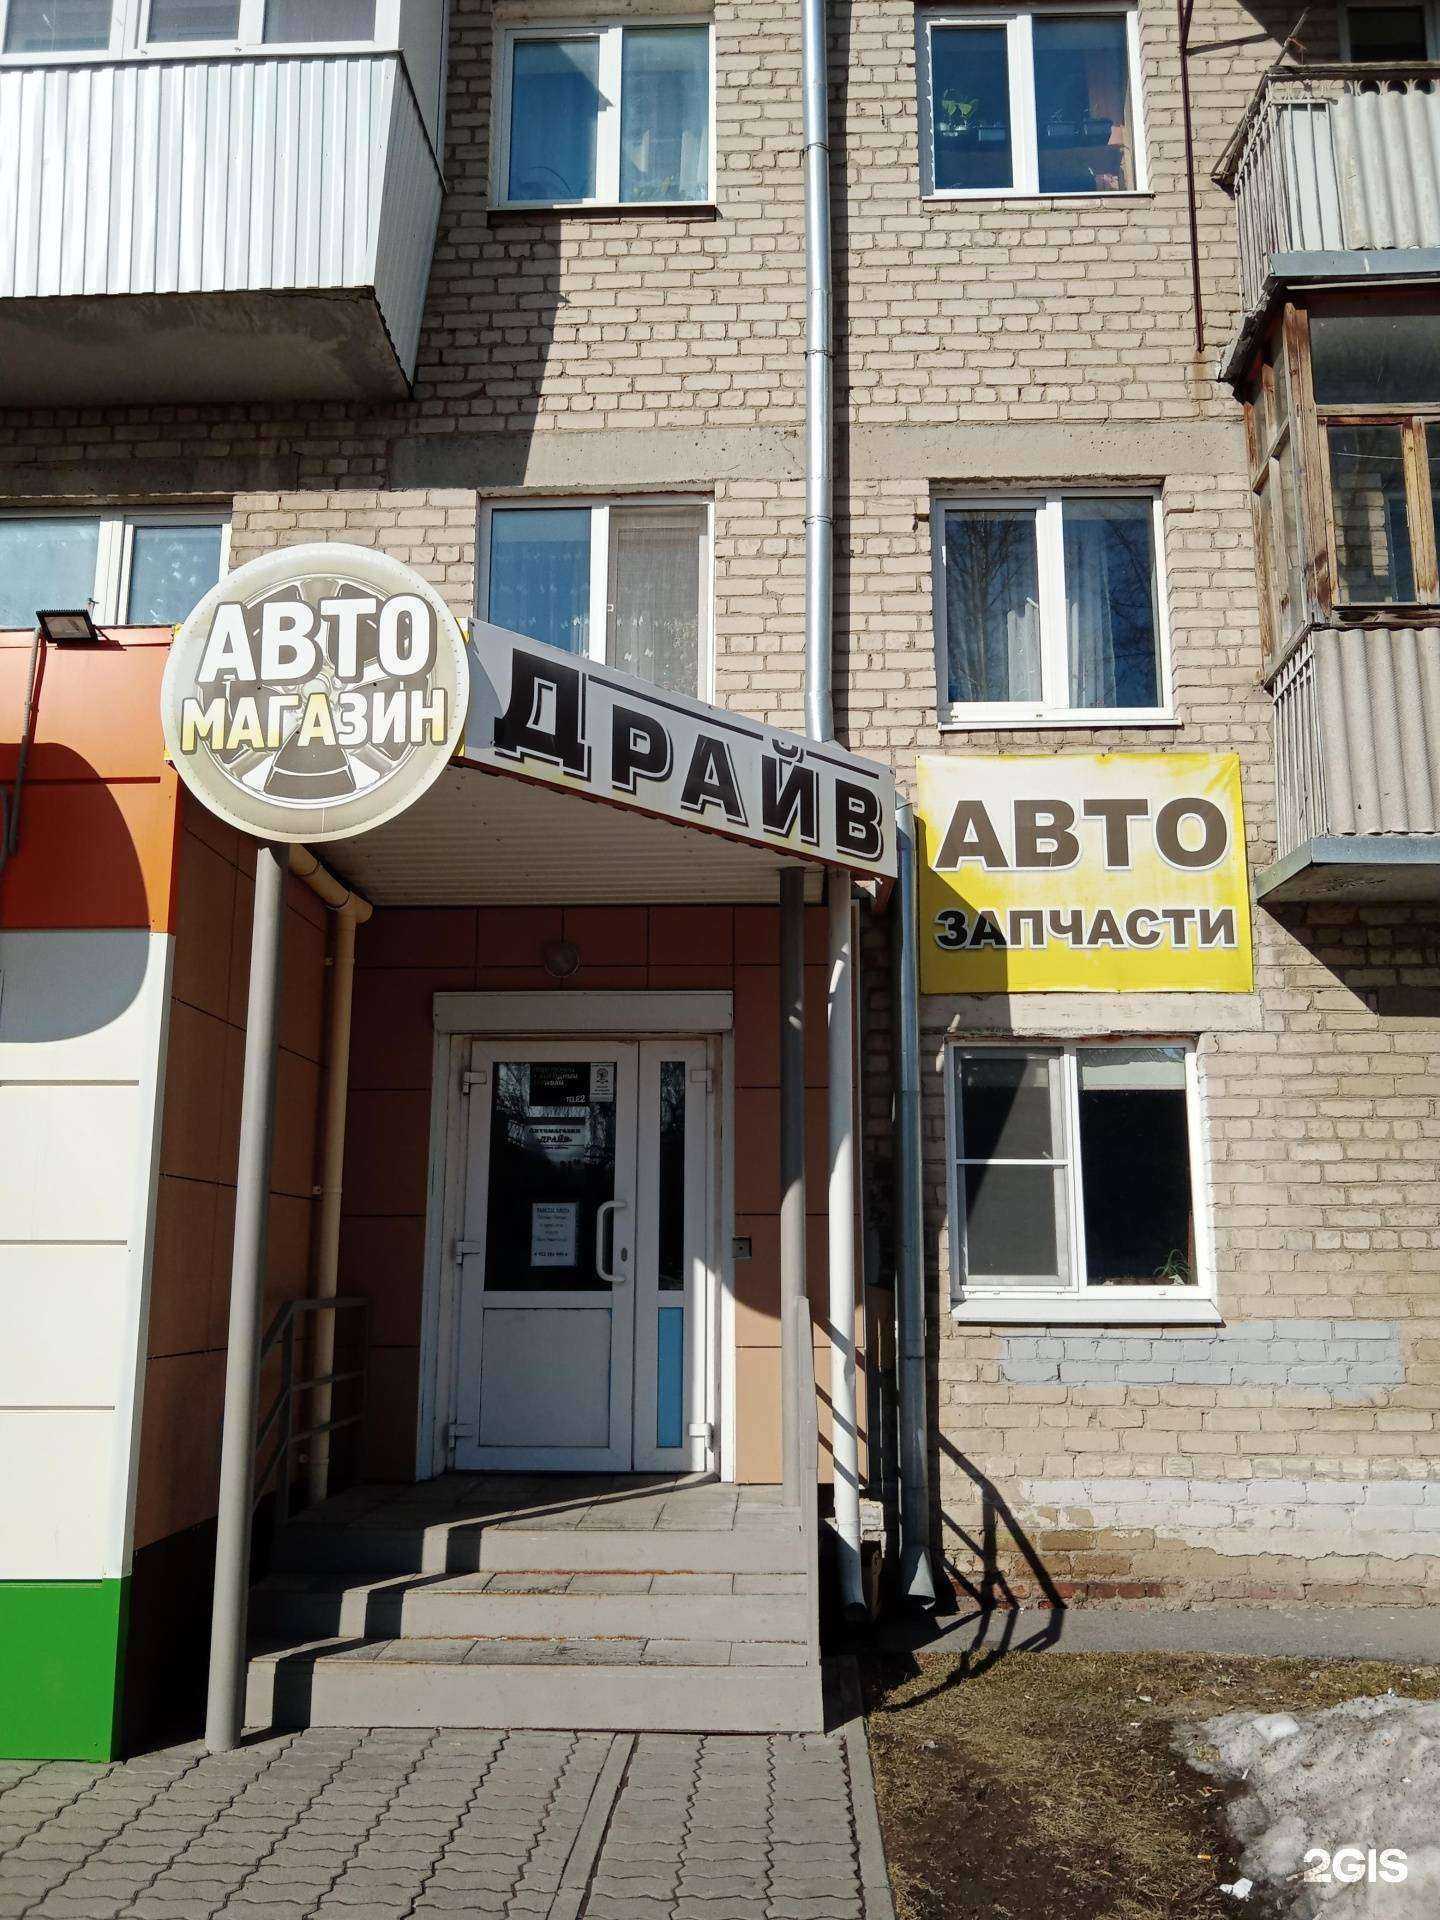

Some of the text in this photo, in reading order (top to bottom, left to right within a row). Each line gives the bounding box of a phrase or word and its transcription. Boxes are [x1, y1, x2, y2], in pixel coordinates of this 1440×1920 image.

[197, 594, 436, 683] АВТО
[180, 688, 447, 754] МАГАЗИН
[494, 649, 885, 860] ДРАЙВ
[934, 797, 1228, 870] АВТО
[934, 908, 1237, 949] ЗАПЧАСТИ
